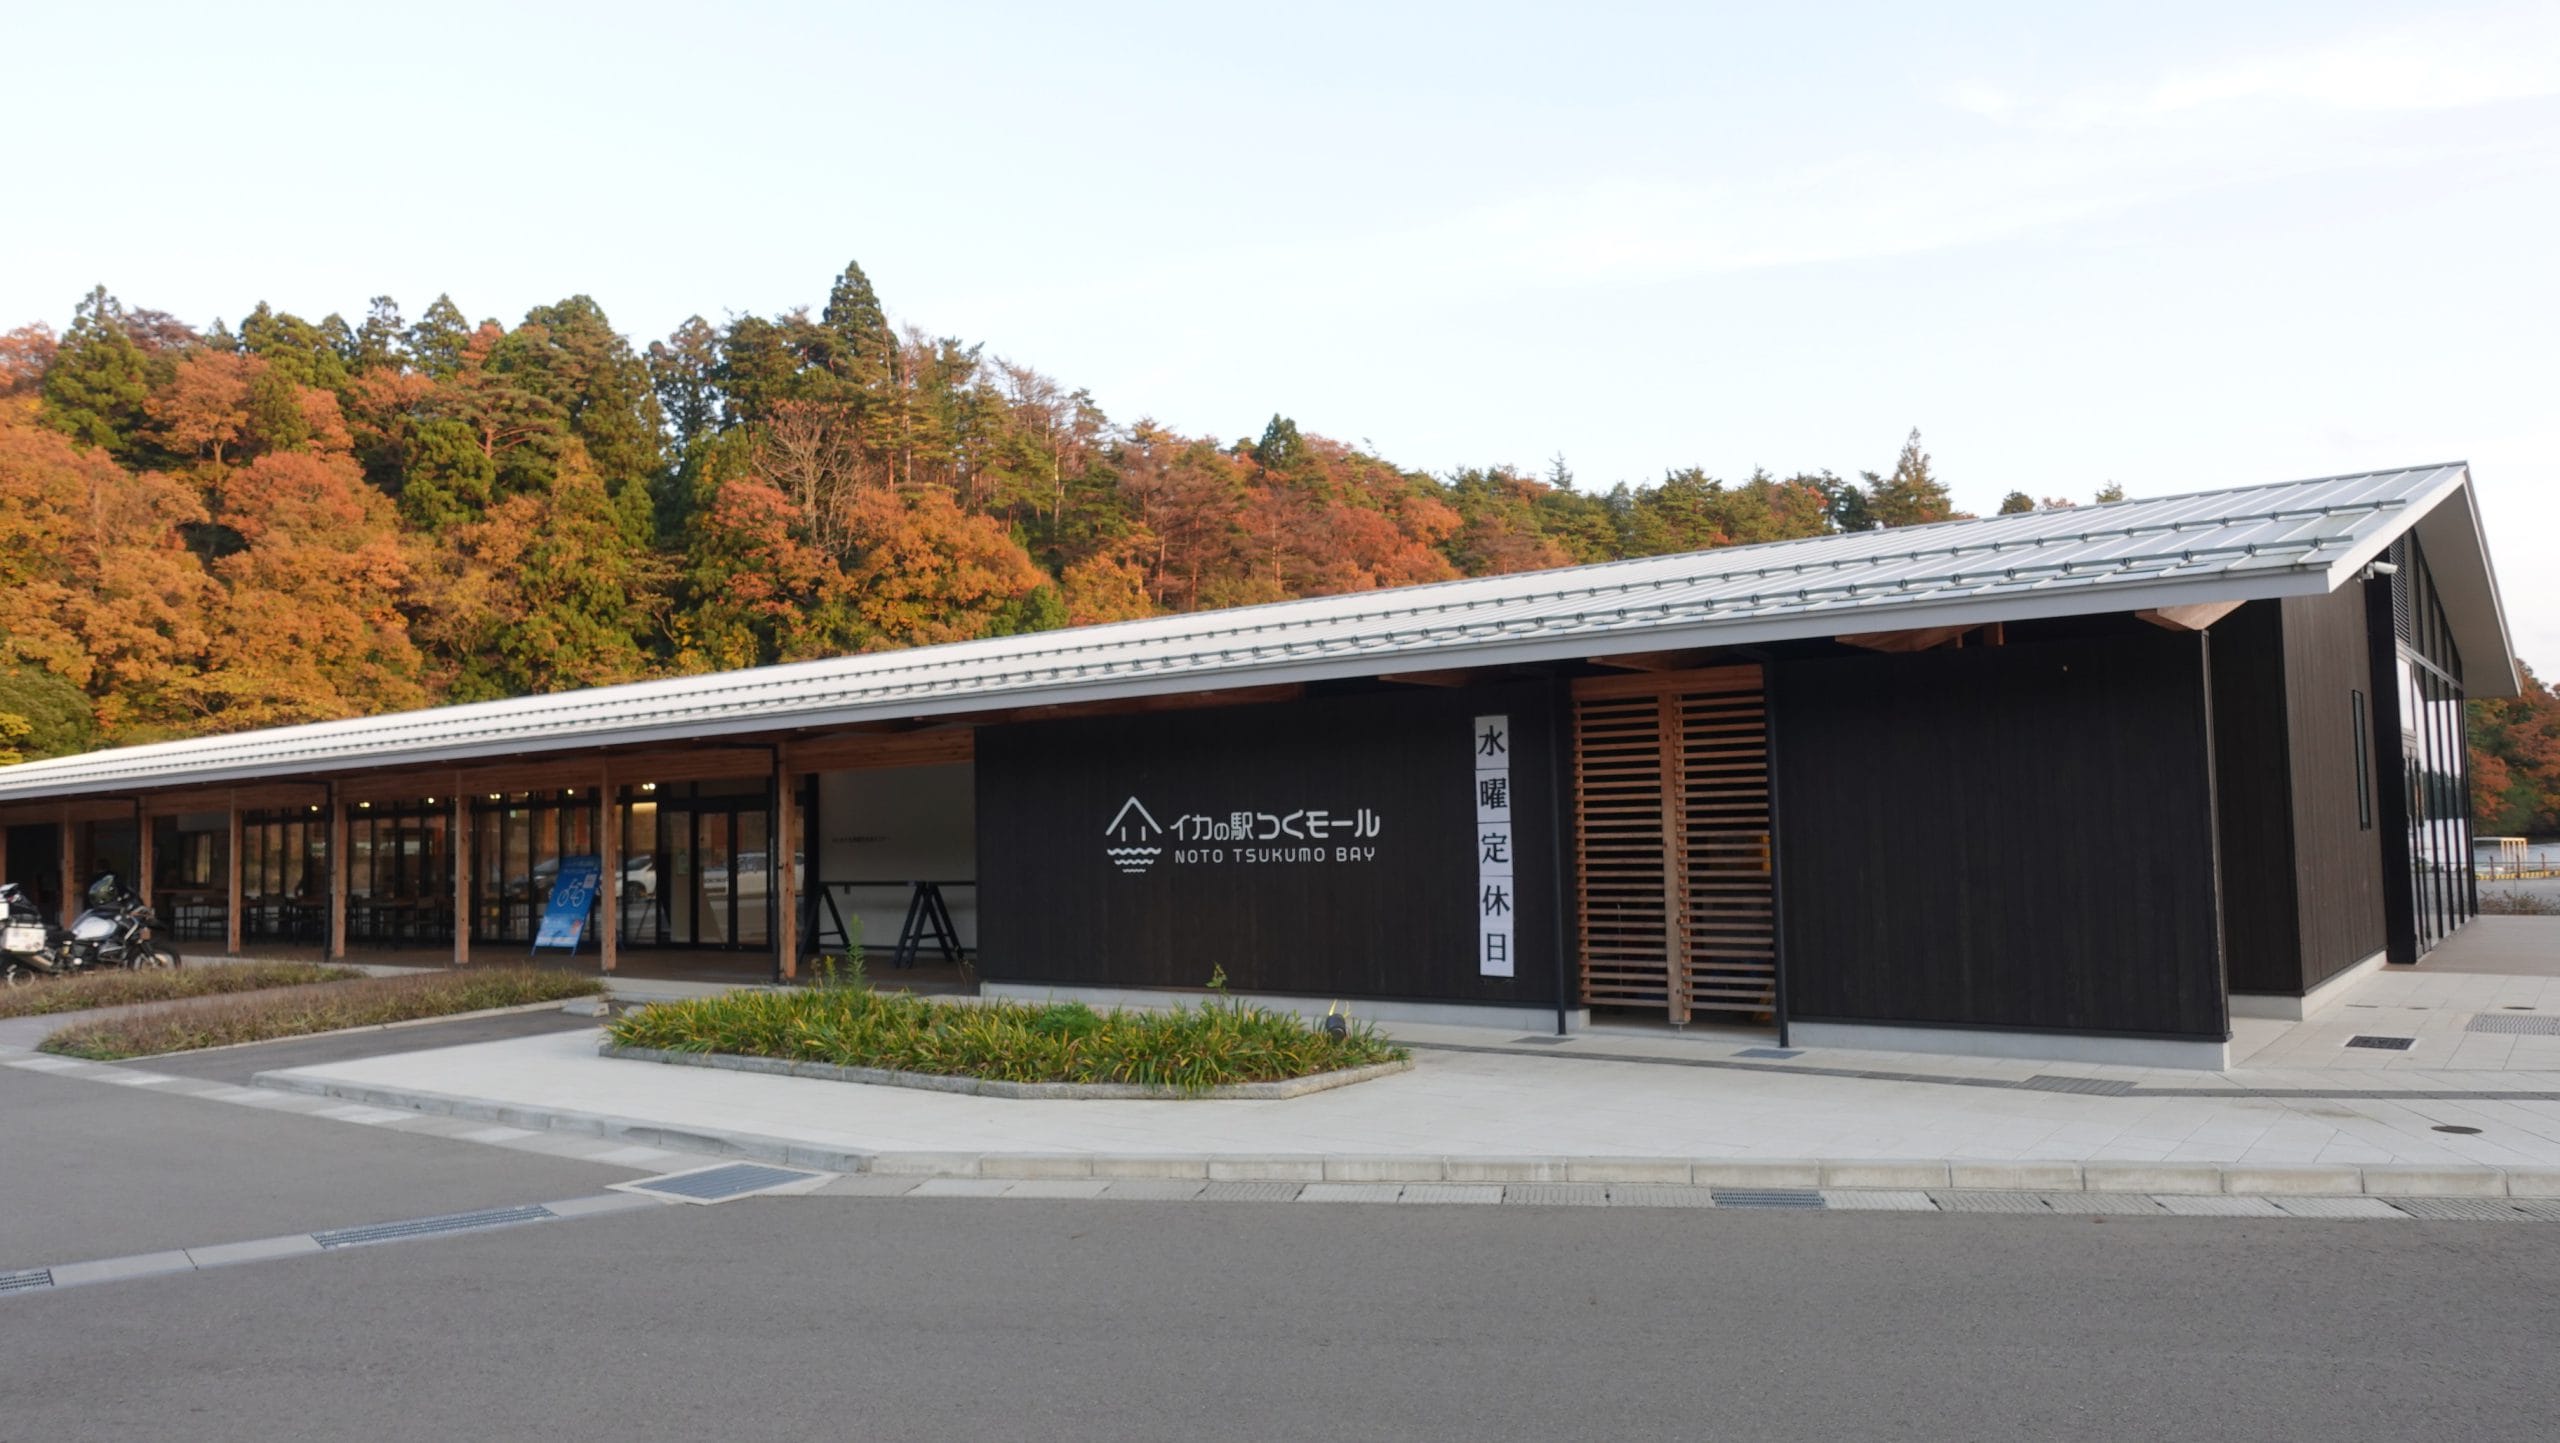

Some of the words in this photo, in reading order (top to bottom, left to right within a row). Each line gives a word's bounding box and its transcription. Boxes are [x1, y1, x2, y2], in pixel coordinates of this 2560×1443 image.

[1169, 808, 1381, 841] イカの駅つくモール
[1174, 848, 1224, 864] NOTO
[1232, 847, 1326, 863] TSUKUMO
[1335, 846, 1376, 862] BAY
[1477, 724, 1511, 962] 水曜定休日
